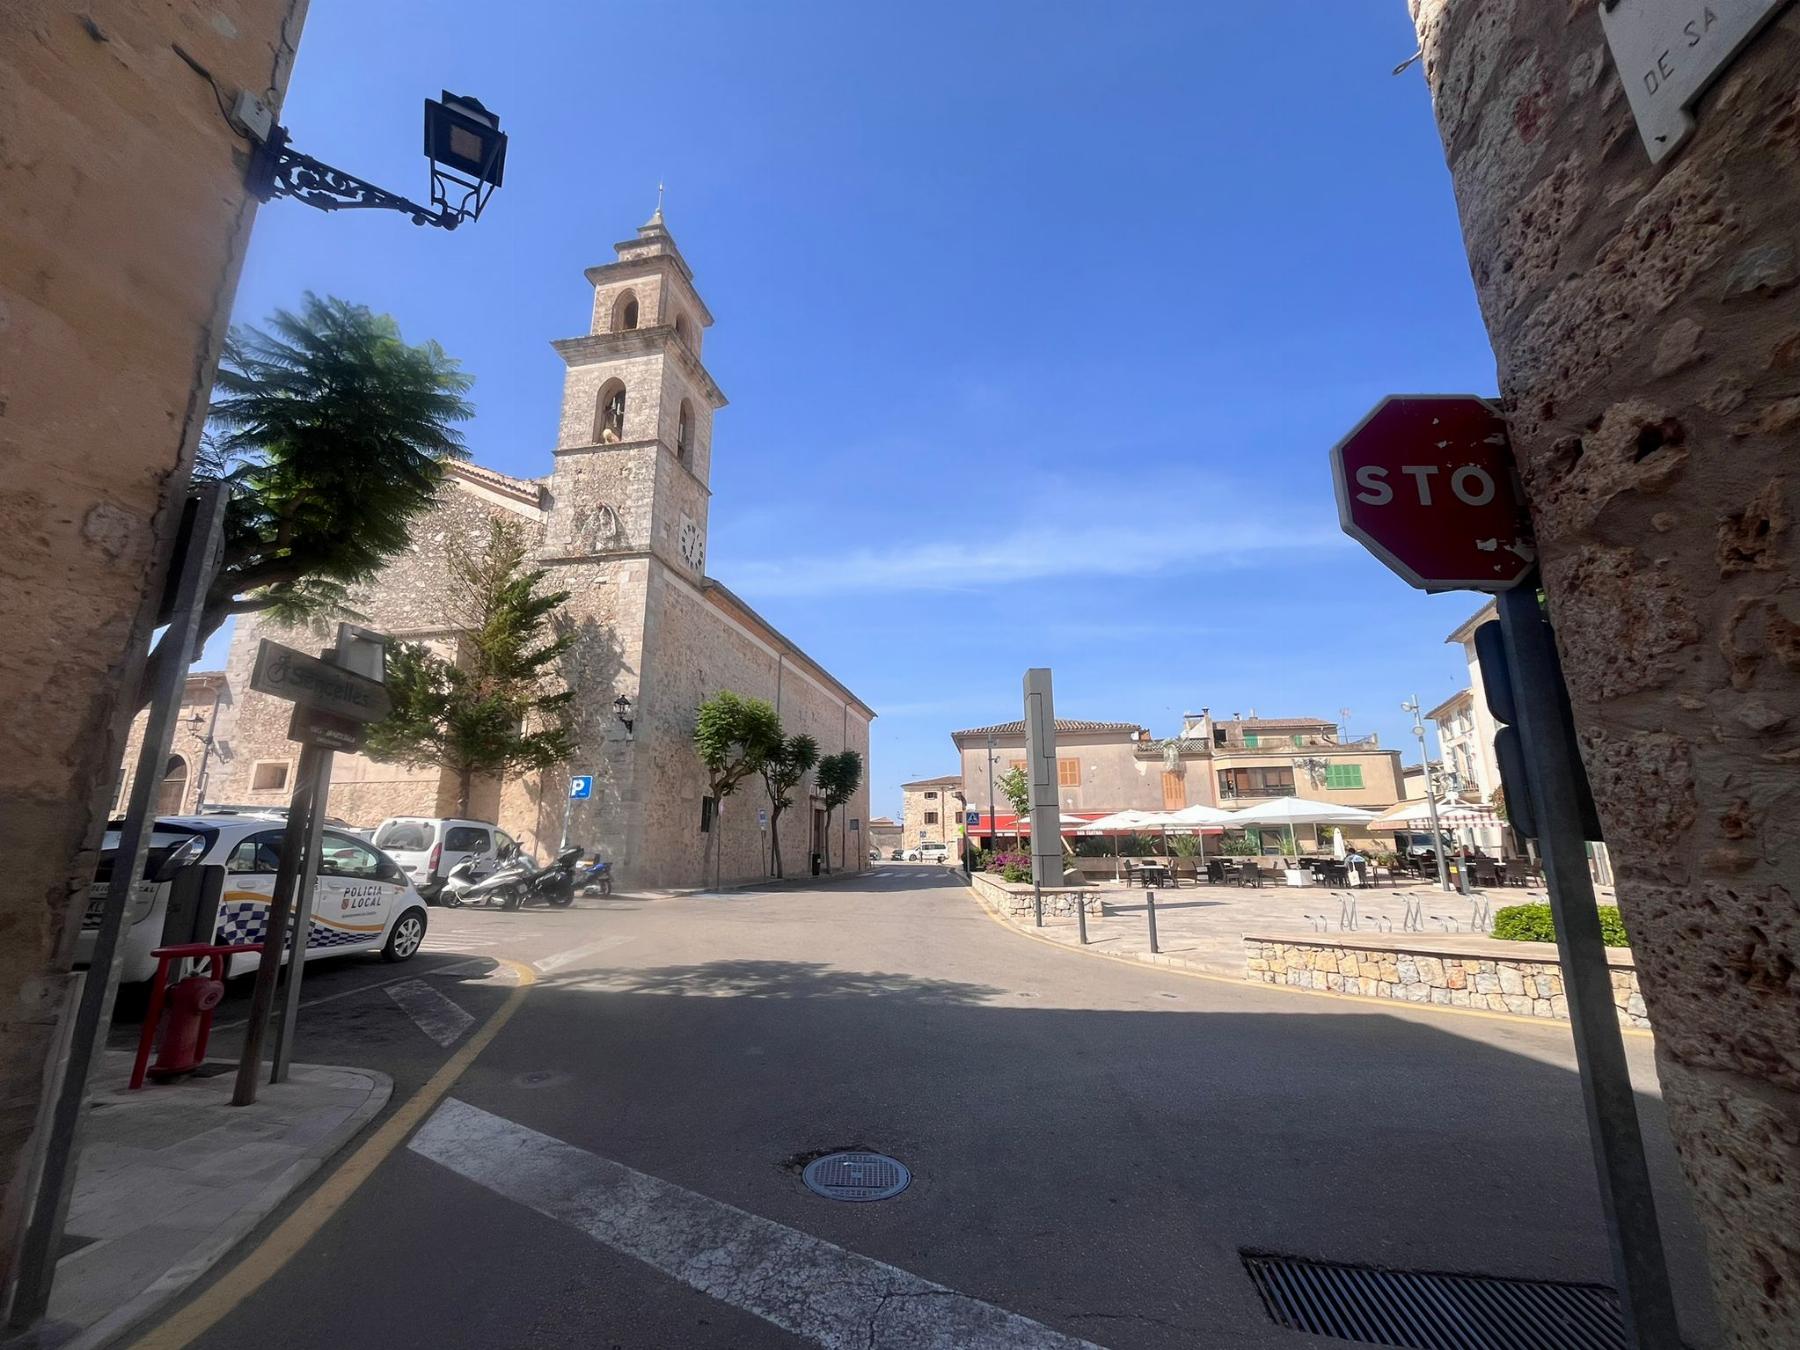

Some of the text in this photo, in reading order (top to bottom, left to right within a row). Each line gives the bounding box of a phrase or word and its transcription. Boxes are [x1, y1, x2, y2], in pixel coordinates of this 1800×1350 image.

[1643, 7, 1719, 95] DE SA
[571, 779, 585, 796] P
[343, 886, 382, 898] POLICIA
[351, 897, 381, 909] LOCAL
